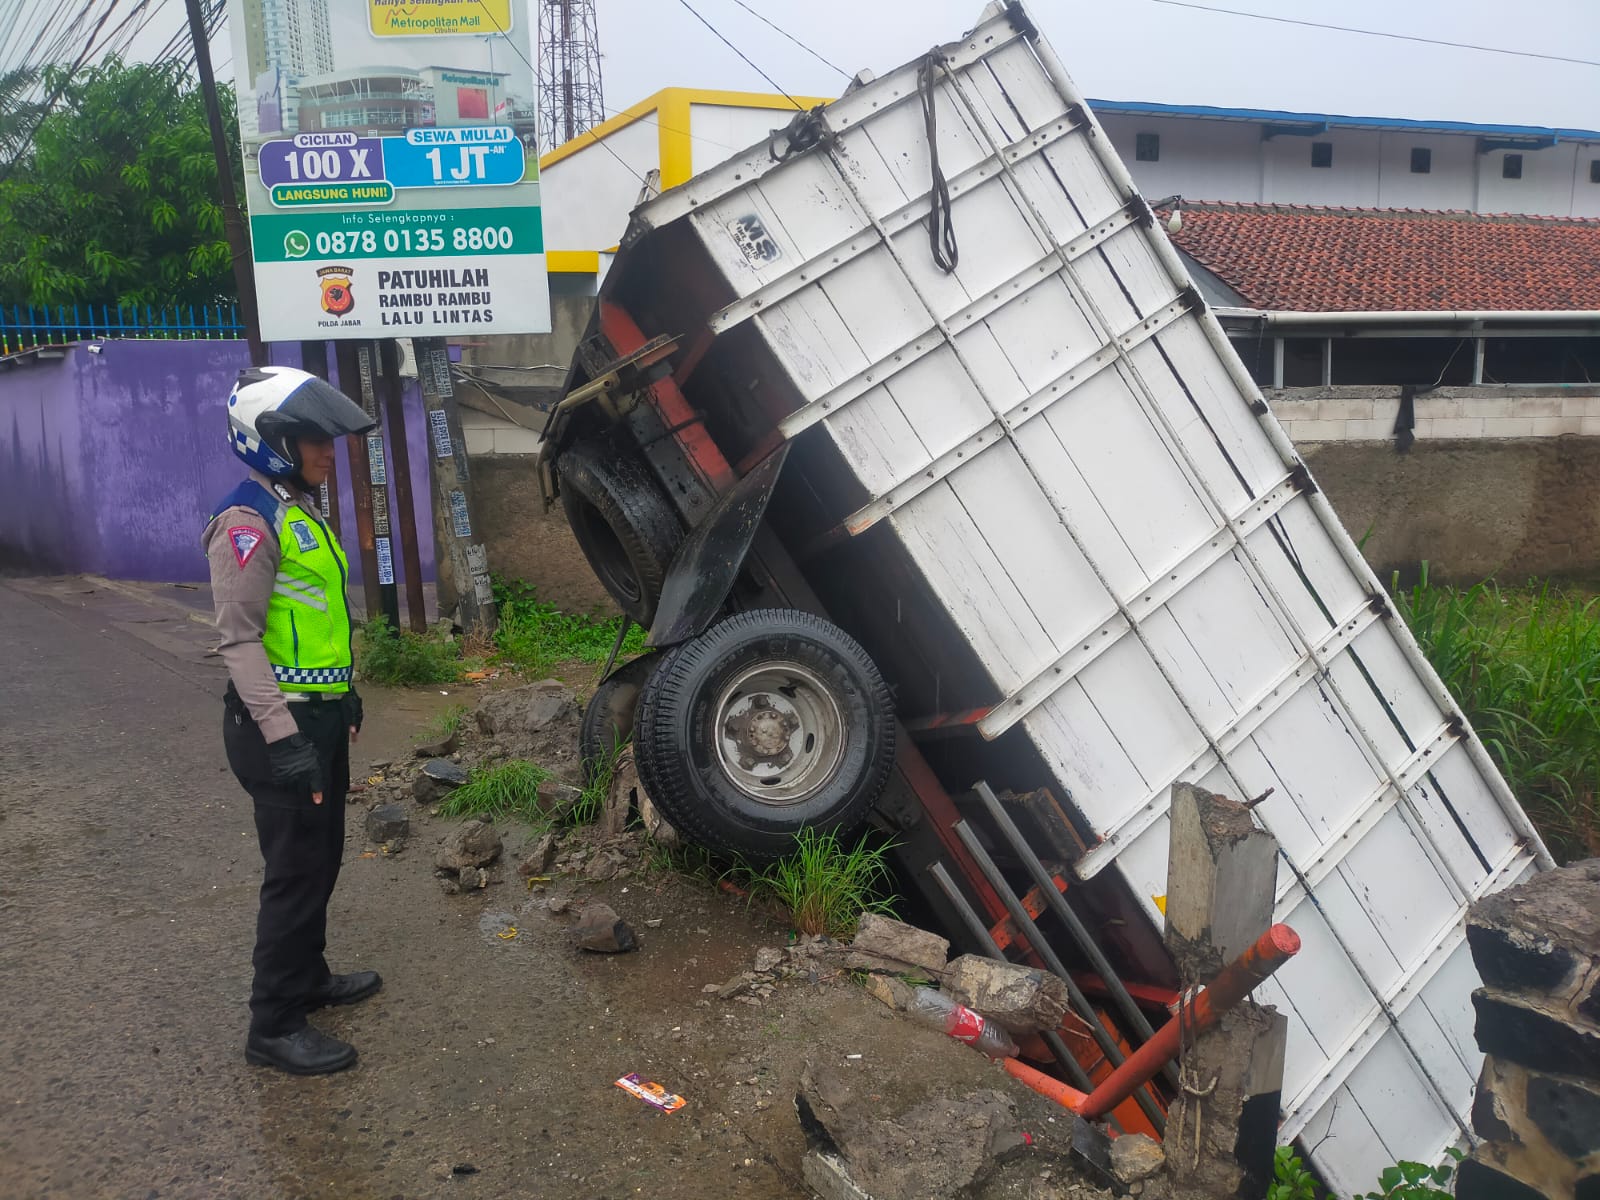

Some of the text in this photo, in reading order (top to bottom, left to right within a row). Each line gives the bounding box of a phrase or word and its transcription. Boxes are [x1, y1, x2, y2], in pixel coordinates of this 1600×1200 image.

[391, 16, 480, 29] Metropolitan Mall
[299, 134, 352, 146] CICILAN
[414, 129, 508, 143] SEWA MULAI
[285, 150, 341, 180] 100
[426, 148, 442, 180] 1
[277, 187, 387, 201] LANGSUNG HUNI!
[342, 214, 363, 224] Info
[368, 212, 447, 226] Selengkapnya
[316, 226, 513, 254] 0878 0135 8800
[378, 269, 489, 290] PATUHILAH
[379, 292, 491, 308] RAMBU RAMBU
[340, 319, 361, 327] JABAR
[381, 309, 493, 325] LALU LINTAS
